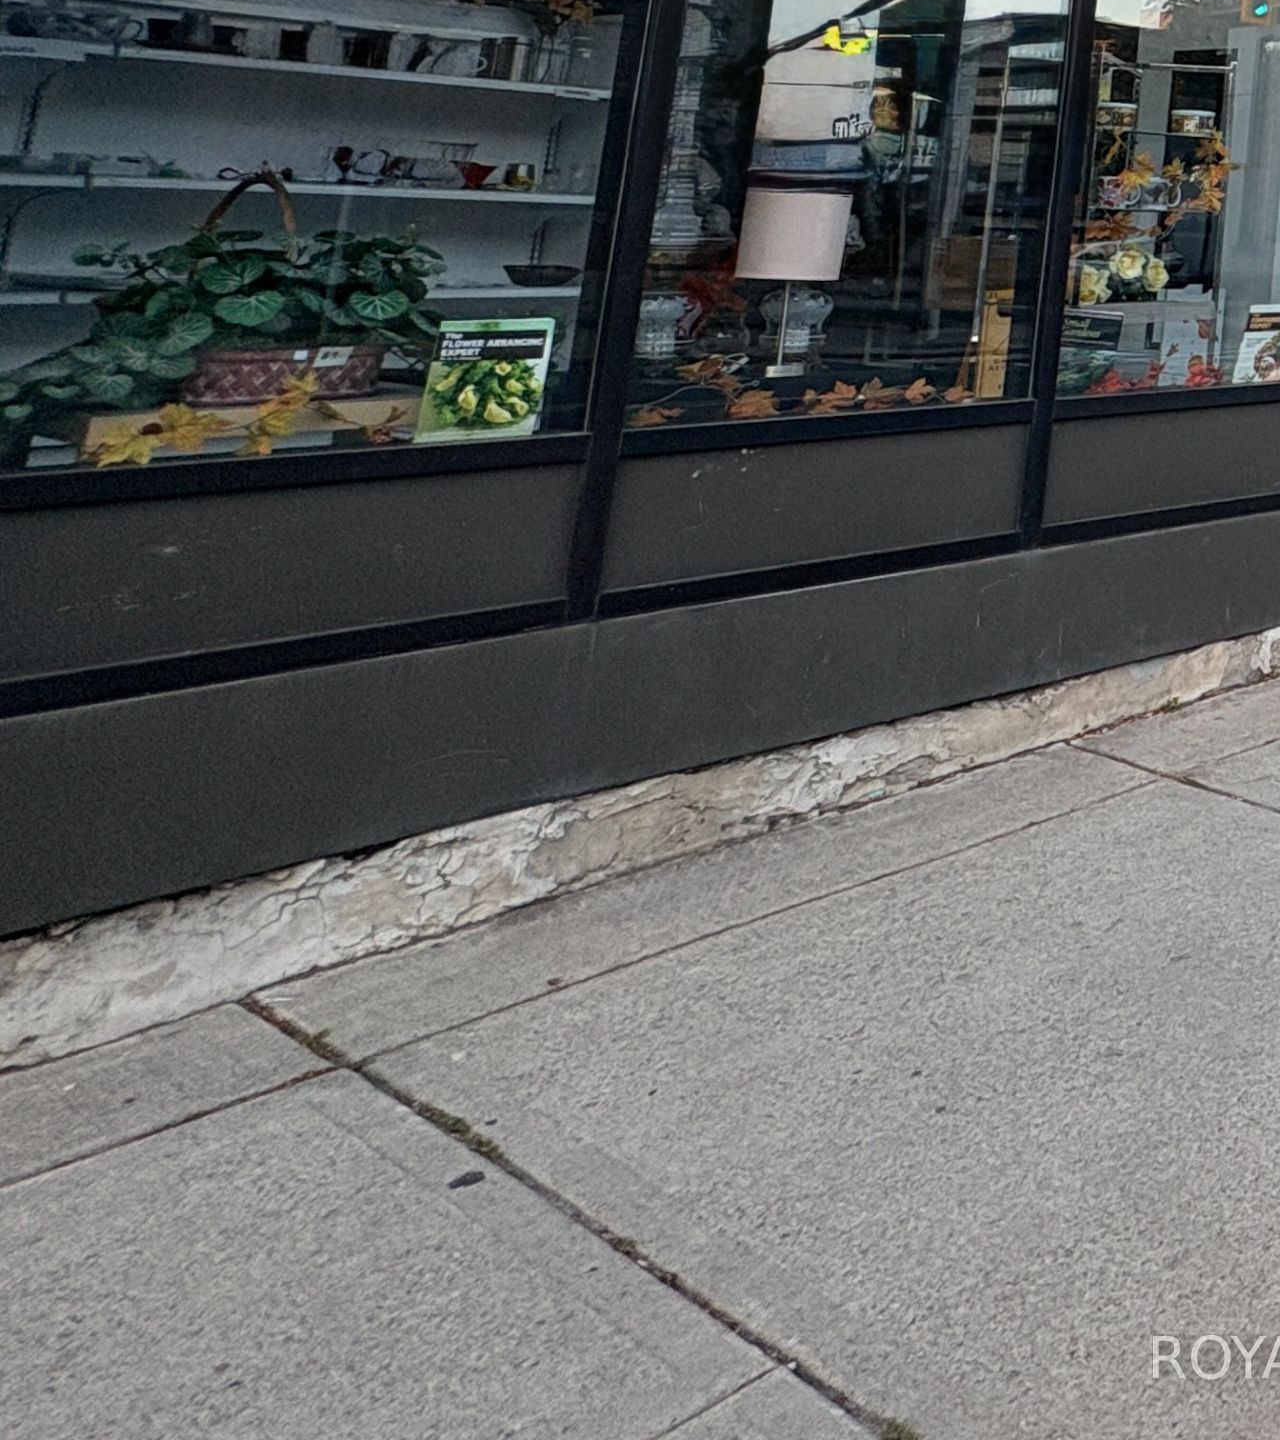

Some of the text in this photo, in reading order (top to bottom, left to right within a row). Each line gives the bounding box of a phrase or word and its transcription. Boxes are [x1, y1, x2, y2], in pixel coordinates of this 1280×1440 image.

[441, 337, 545, 348] FLOWER ARRANGING
[440, 347, 482, 357] EXPERT
